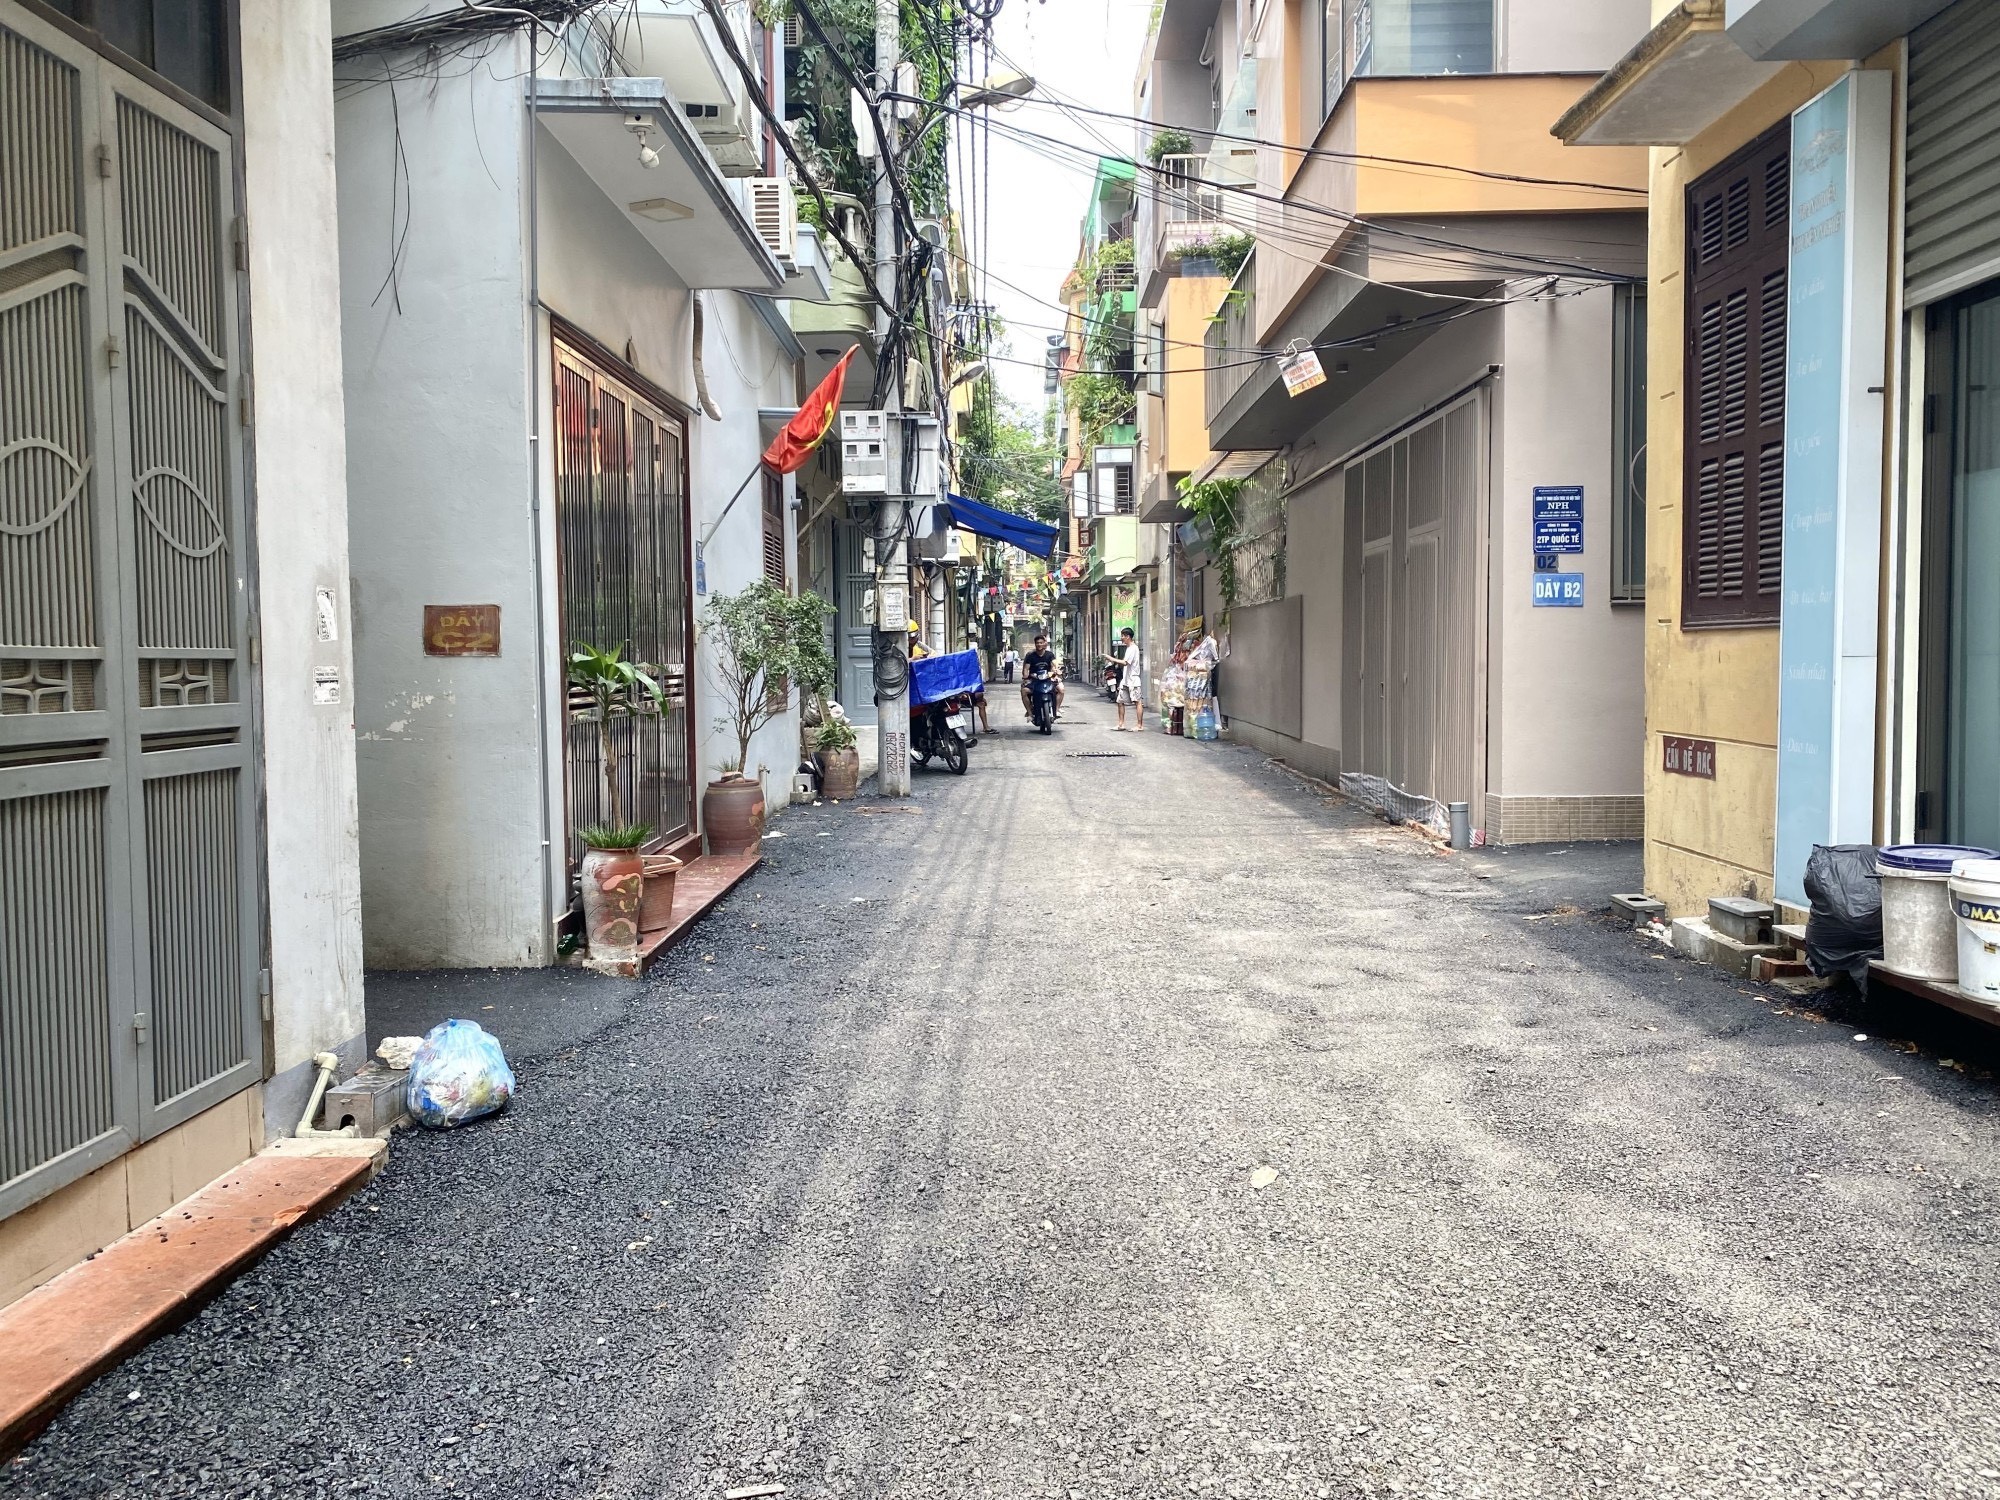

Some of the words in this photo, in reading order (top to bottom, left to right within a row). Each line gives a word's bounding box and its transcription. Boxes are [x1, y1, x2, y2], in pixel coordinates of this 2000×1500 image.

[1551, 533, 1570, 544] QUỐC
[1571, 533, 1580, 543] TẾ
[1537, 555, 1556, 569] 02
[1536, 579, 1560, 598] DÃY
[1564, 582, 1580, 598] B2
